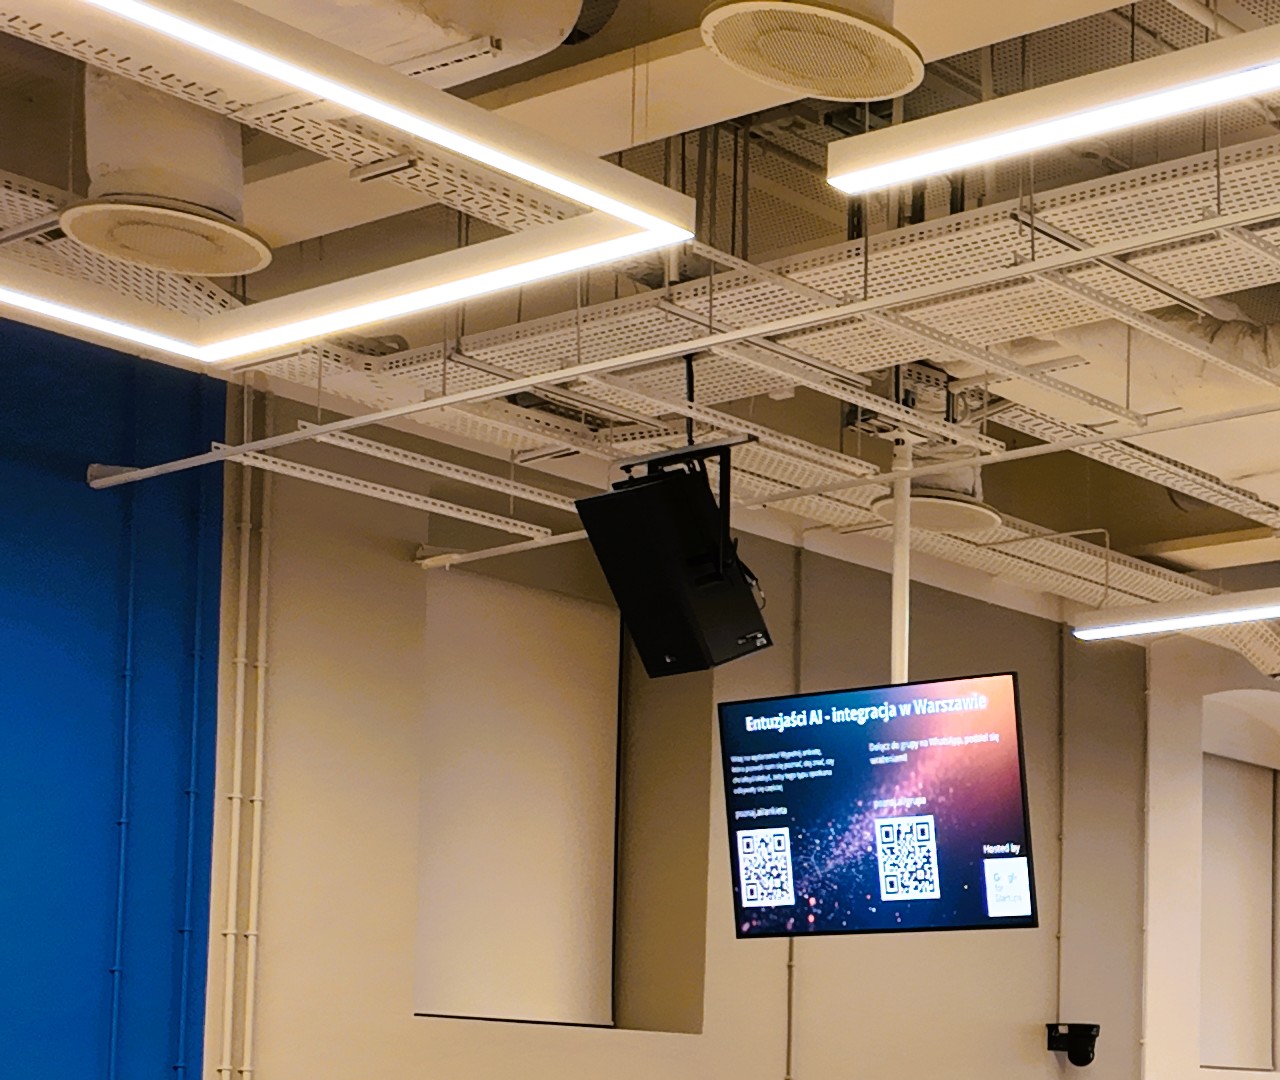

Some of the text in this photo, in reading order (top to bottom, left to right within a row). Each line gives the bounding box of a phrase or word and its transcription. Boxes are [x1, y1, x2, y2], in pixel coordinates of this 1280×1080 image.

[745, 709, 807, 733] Entuzjaści
[809, 709, 823, 725] AI
[832, 702, 896, 725] integracja
[899, 704, 912, 716] w
[913, 693, 989, 715] Warszawie
[1010, 843, 1020, 855] by
